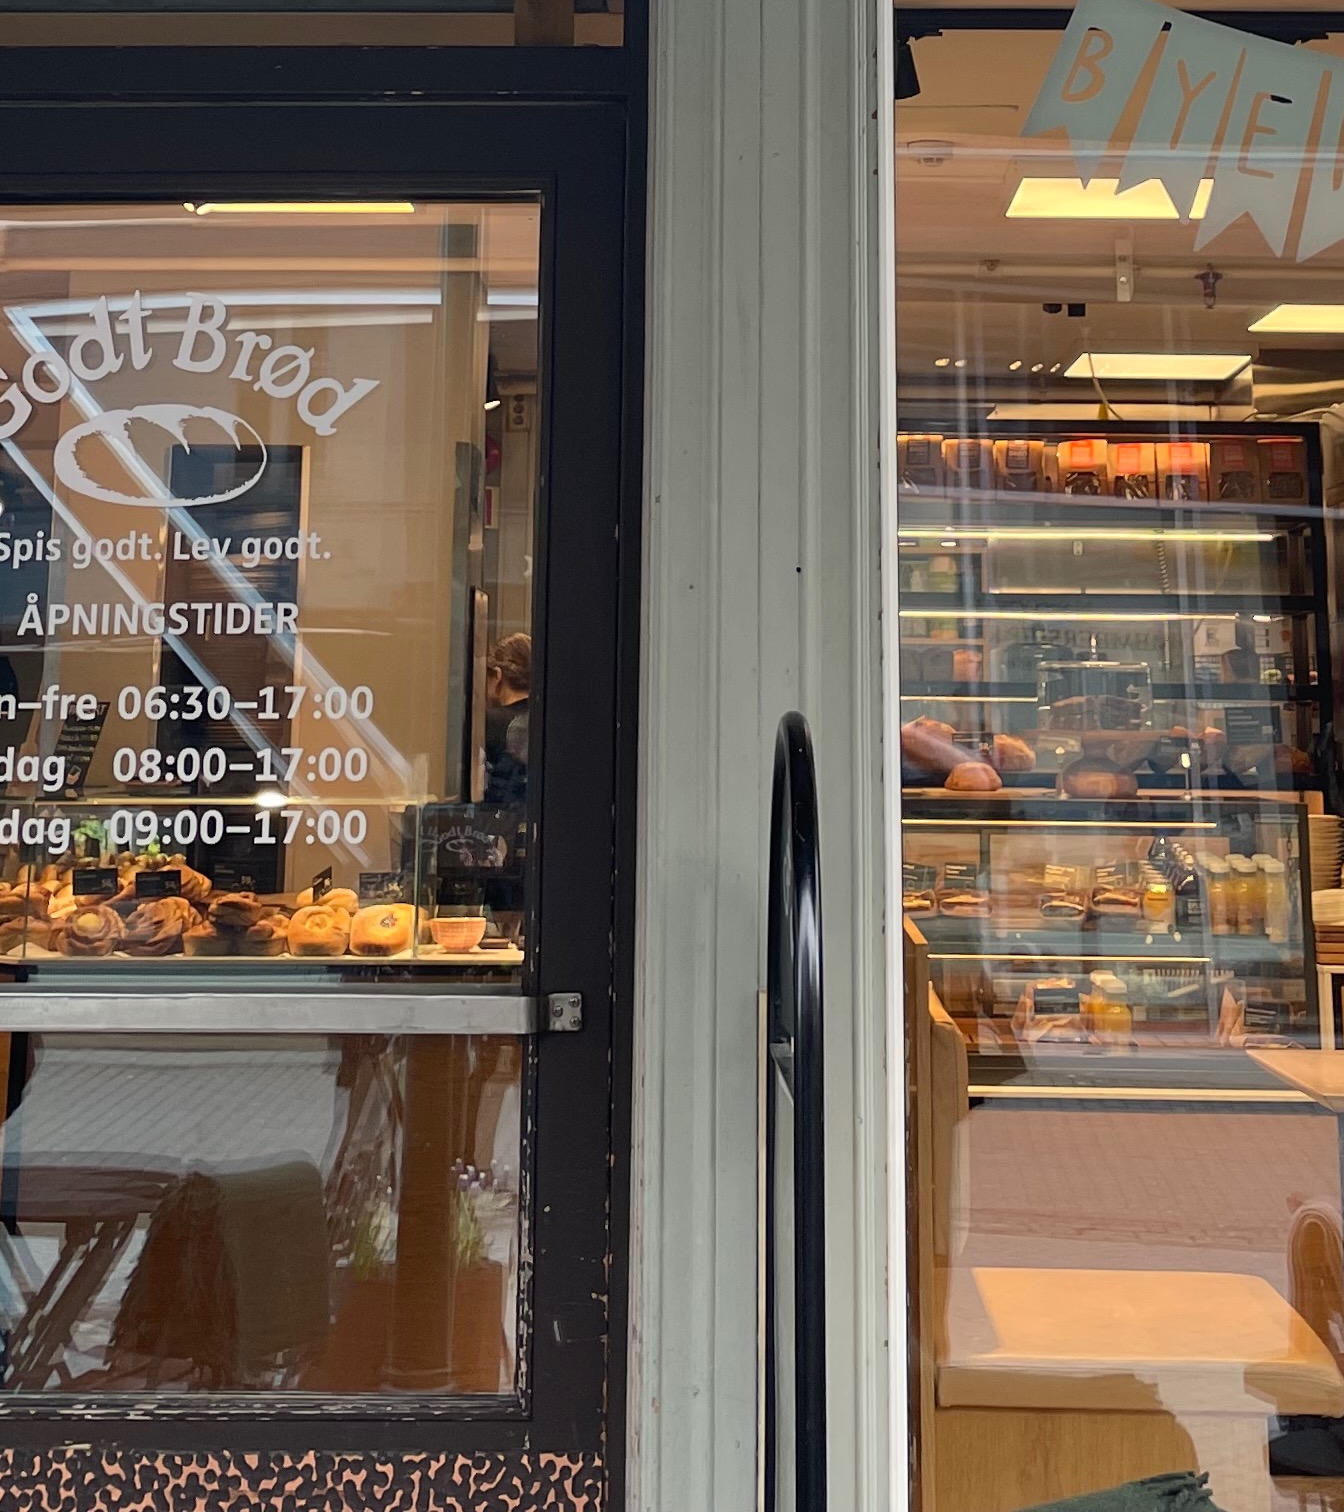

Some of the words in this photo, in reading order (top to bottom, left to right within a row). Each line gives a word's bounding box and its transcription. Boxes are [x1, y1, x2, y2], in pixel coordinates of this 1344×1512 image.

[172, 291, 380, 437] Brød
[72, 531, 162, 569] godt.
[173, 533, 232, 562] Lev
[241, 532, 331, 569] godt.
[17, 593, 299, 636] ÅPNINGSTIDER
